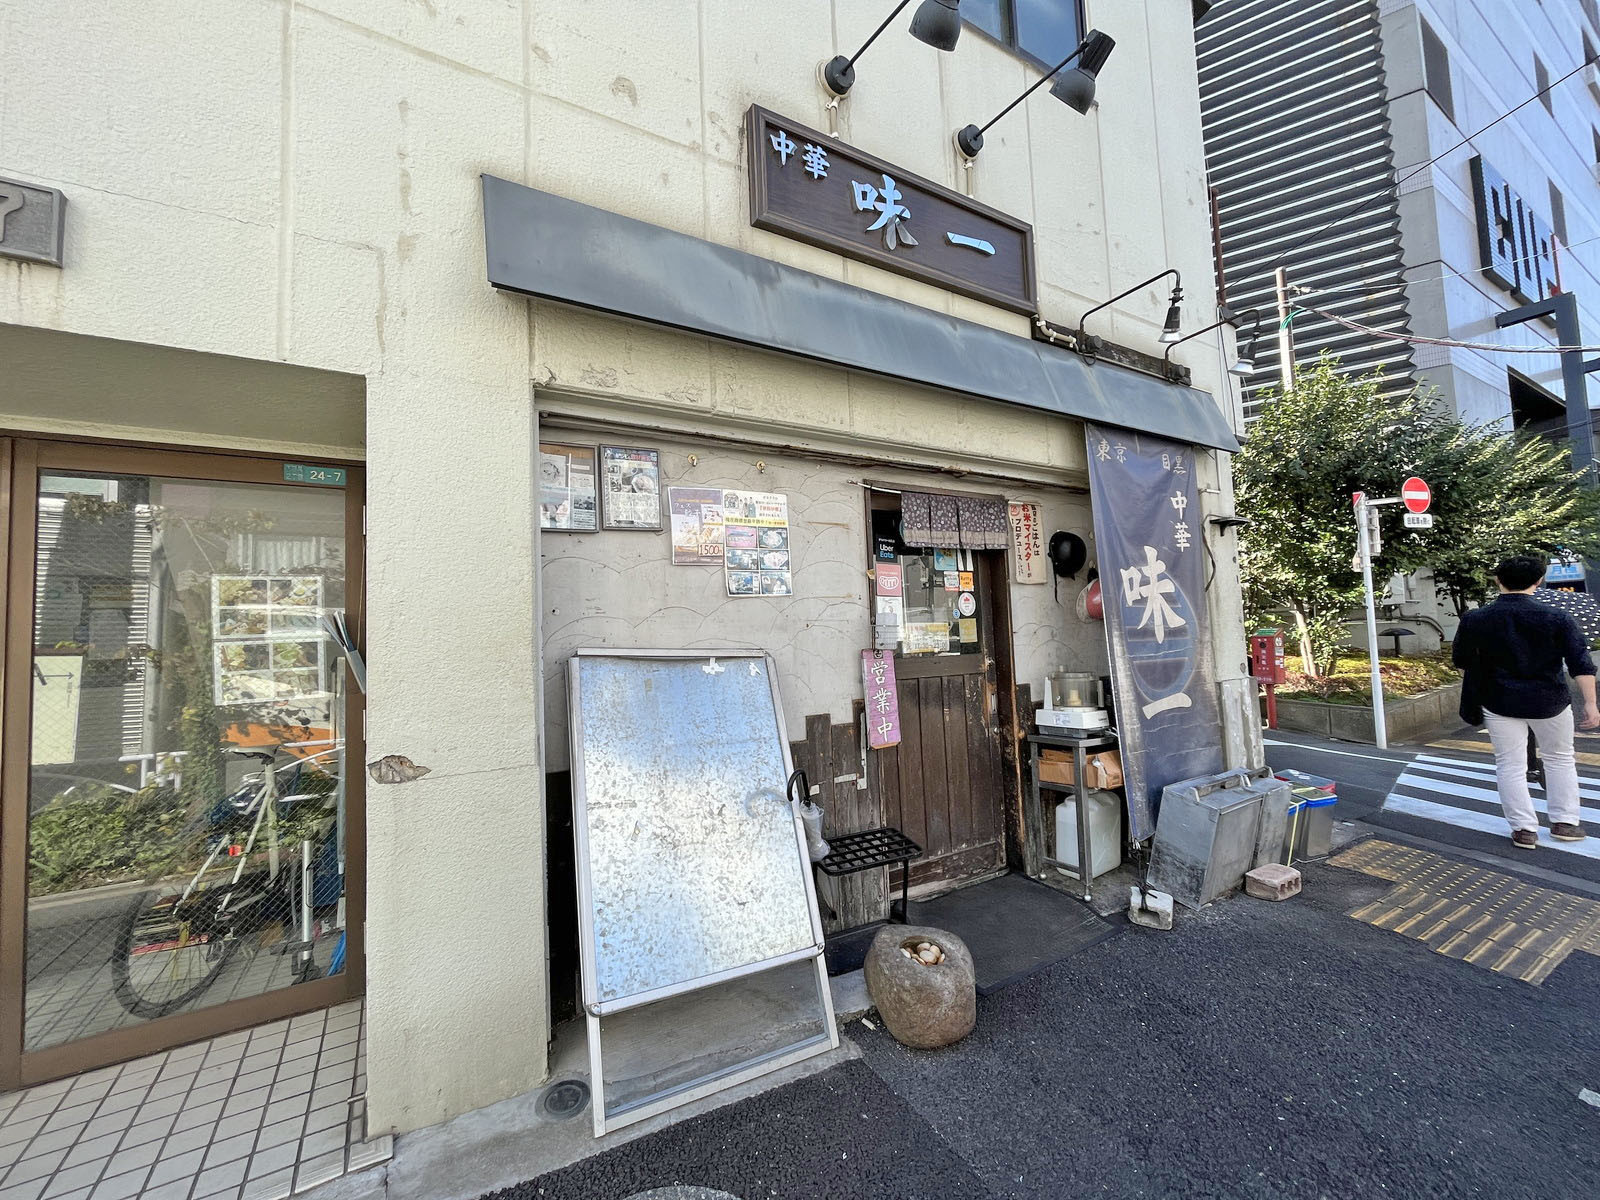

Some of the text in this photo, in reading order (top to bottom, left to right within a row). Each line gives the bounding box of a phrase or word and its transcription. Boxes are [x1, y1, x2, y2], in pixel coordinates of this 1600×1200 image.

[769, 130, 996, 255] 中華 味一
[310, 470, 341, 482] 24-7
[1096, 439, 1187, 474] 東京 目黒
[1170, 490, 1191, 552] 中華
[879, 551, 894, 559] Eats
[1120, 545, 1192, 720] 味一
[871, 660, 893, 742] 営業中
